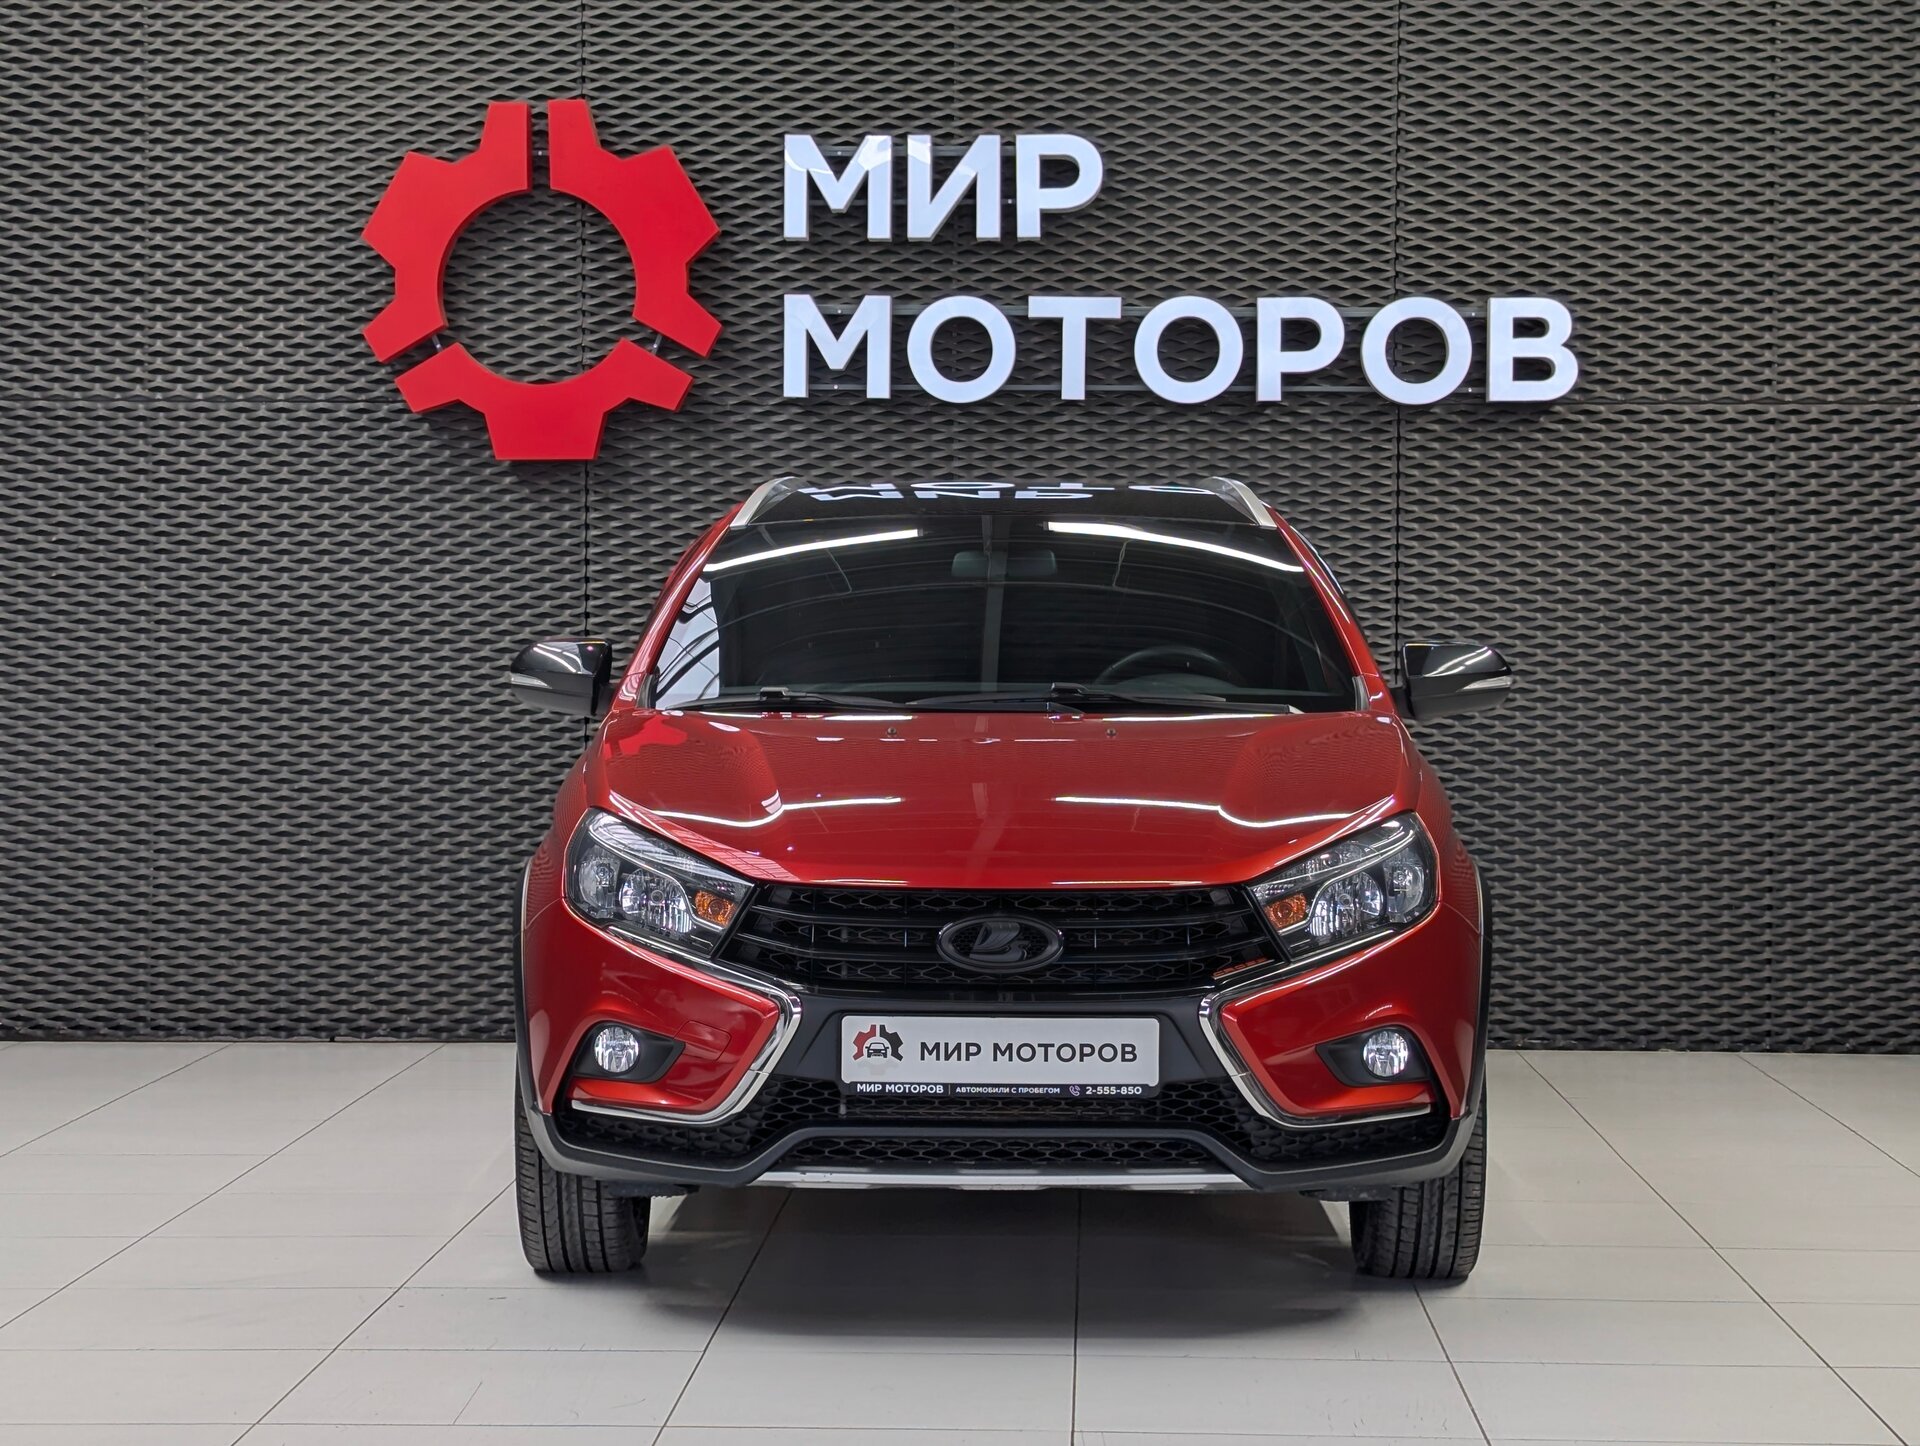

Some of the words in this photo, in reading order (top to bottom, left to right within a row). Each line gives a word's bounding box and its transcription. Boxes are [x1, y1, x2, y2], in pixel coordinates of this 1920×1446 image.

[783, 134, 1105, 242] МИР
[782, 293, 1580, 405] МОТОРОВ
[919, 1041, 982, 1062] МИР
[992, 1041, 1138, 1063] МОТОРОВ
[856, 1083, 883, 1093] МИР
[885, 1083, 944, 1094] МОТОРОВ
[955, 1085, 1010, 1094] АВТОМОБИЛИ
[1011, 1086, 1017, 1094] С
[1018, 1086, 1061, 1095] ПРОБЕГОМ
[1085, 1086, 1142, 1095] 2-555-850
